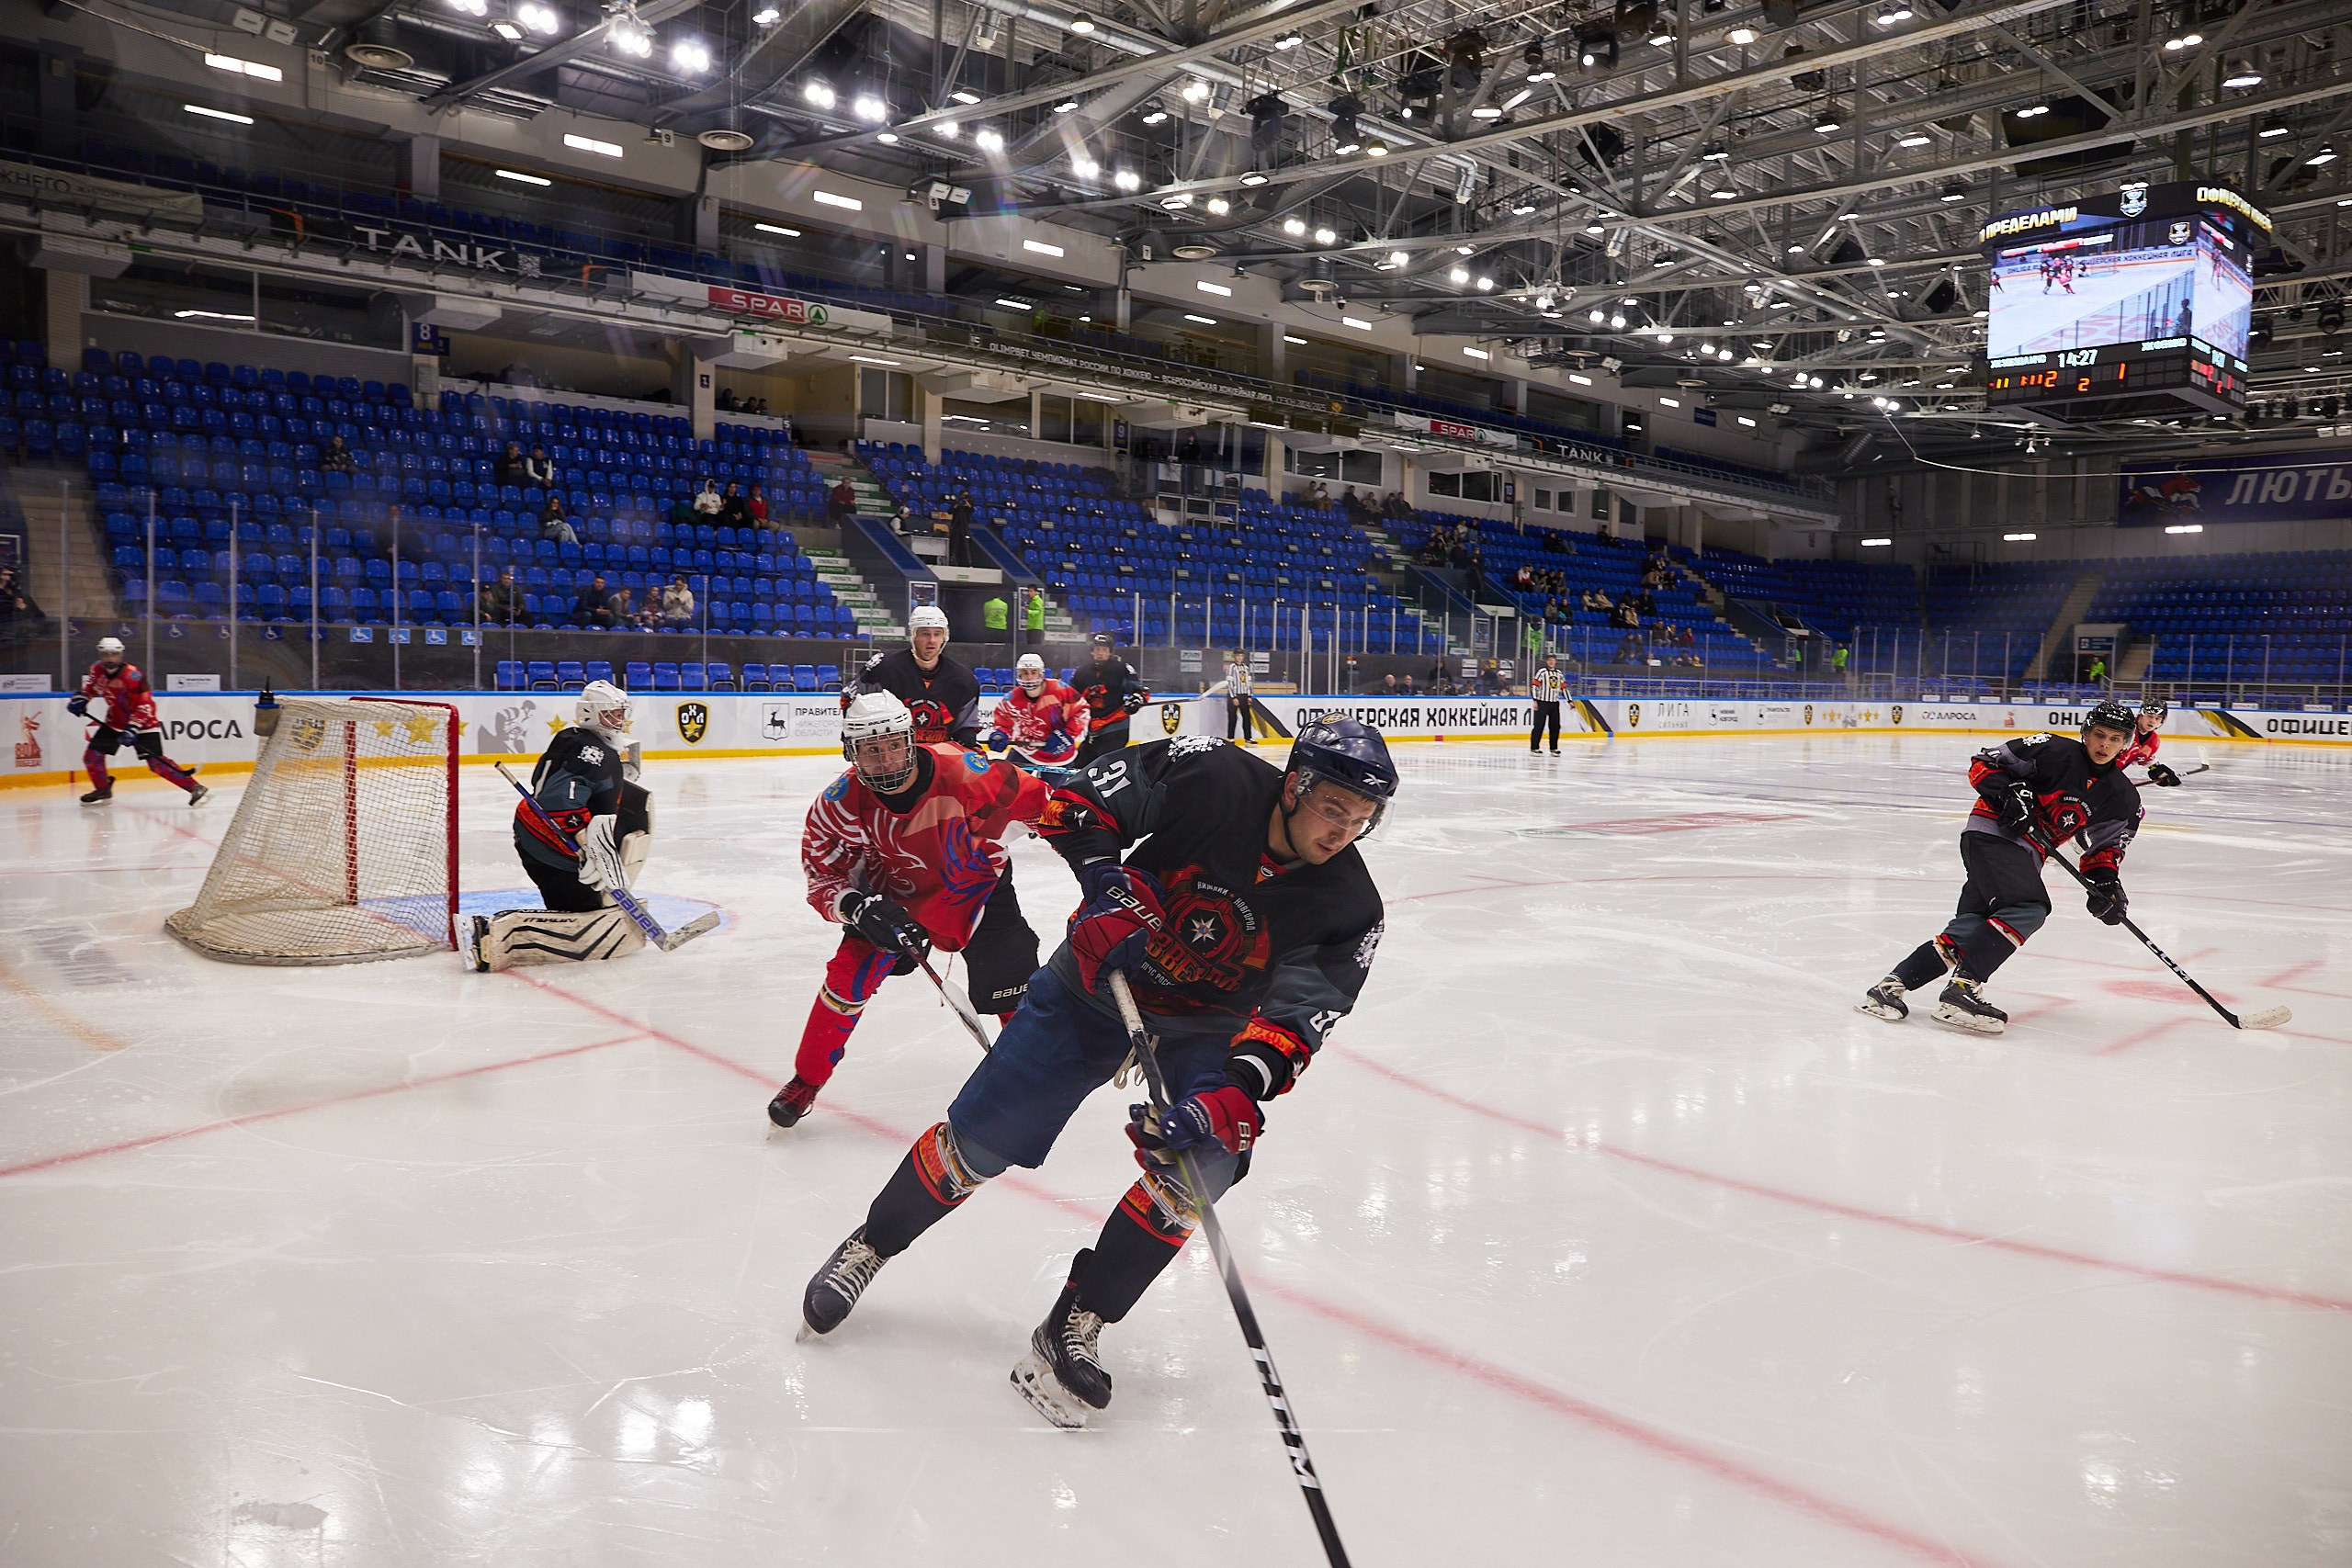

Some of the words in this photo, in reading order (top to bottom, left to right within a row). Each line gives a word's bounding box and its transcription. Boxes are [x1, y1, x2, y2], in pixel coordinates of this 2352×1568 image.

[1985, 207, 2078, 240] ПРЕДЕЛАМИ
[354, 225, 506, 273] TANK
[731, 293, 803, 318] SPAR
[419, 323, 431, 341] 8
[1117, 424, 1125, 438] 9
[1440, 423, 1476, 440] SPAR
[1556, 444, 1603, 464] TANK
[1426, 702, 1518, 727] ХОККЕЙНАЯ
[1657, 703, 1690, 717] ЛИГА
[610, 888, 661, 940] BAUER
